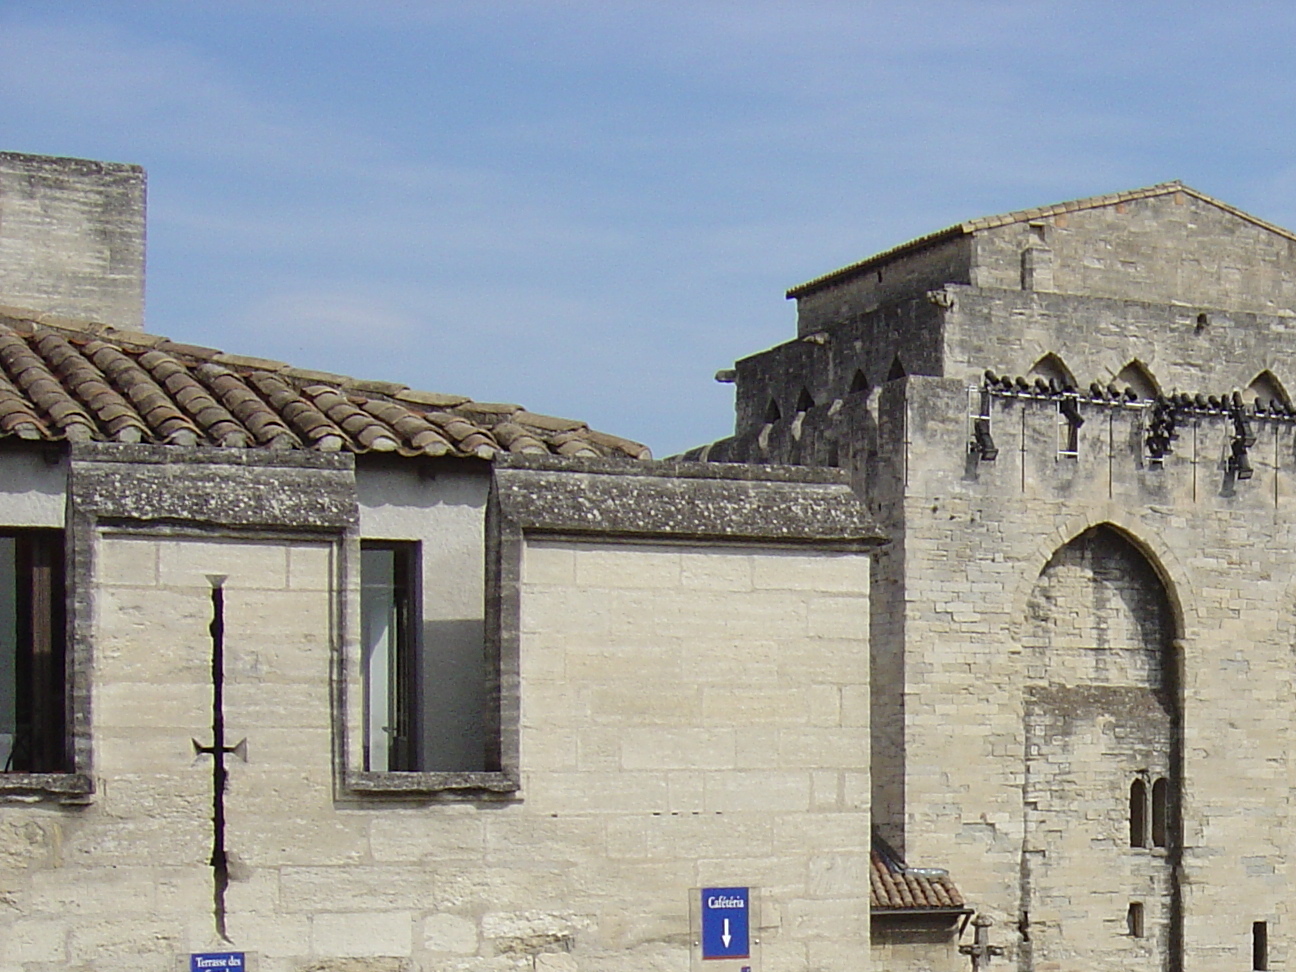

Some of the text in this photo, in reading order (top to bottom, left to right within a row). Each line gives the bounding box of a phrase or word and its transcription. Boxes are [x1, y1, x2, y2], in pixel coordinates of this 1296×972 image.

[708, 895, 745, 909] Cafétéria
[195, 955, 241, 968] Terrasse des
